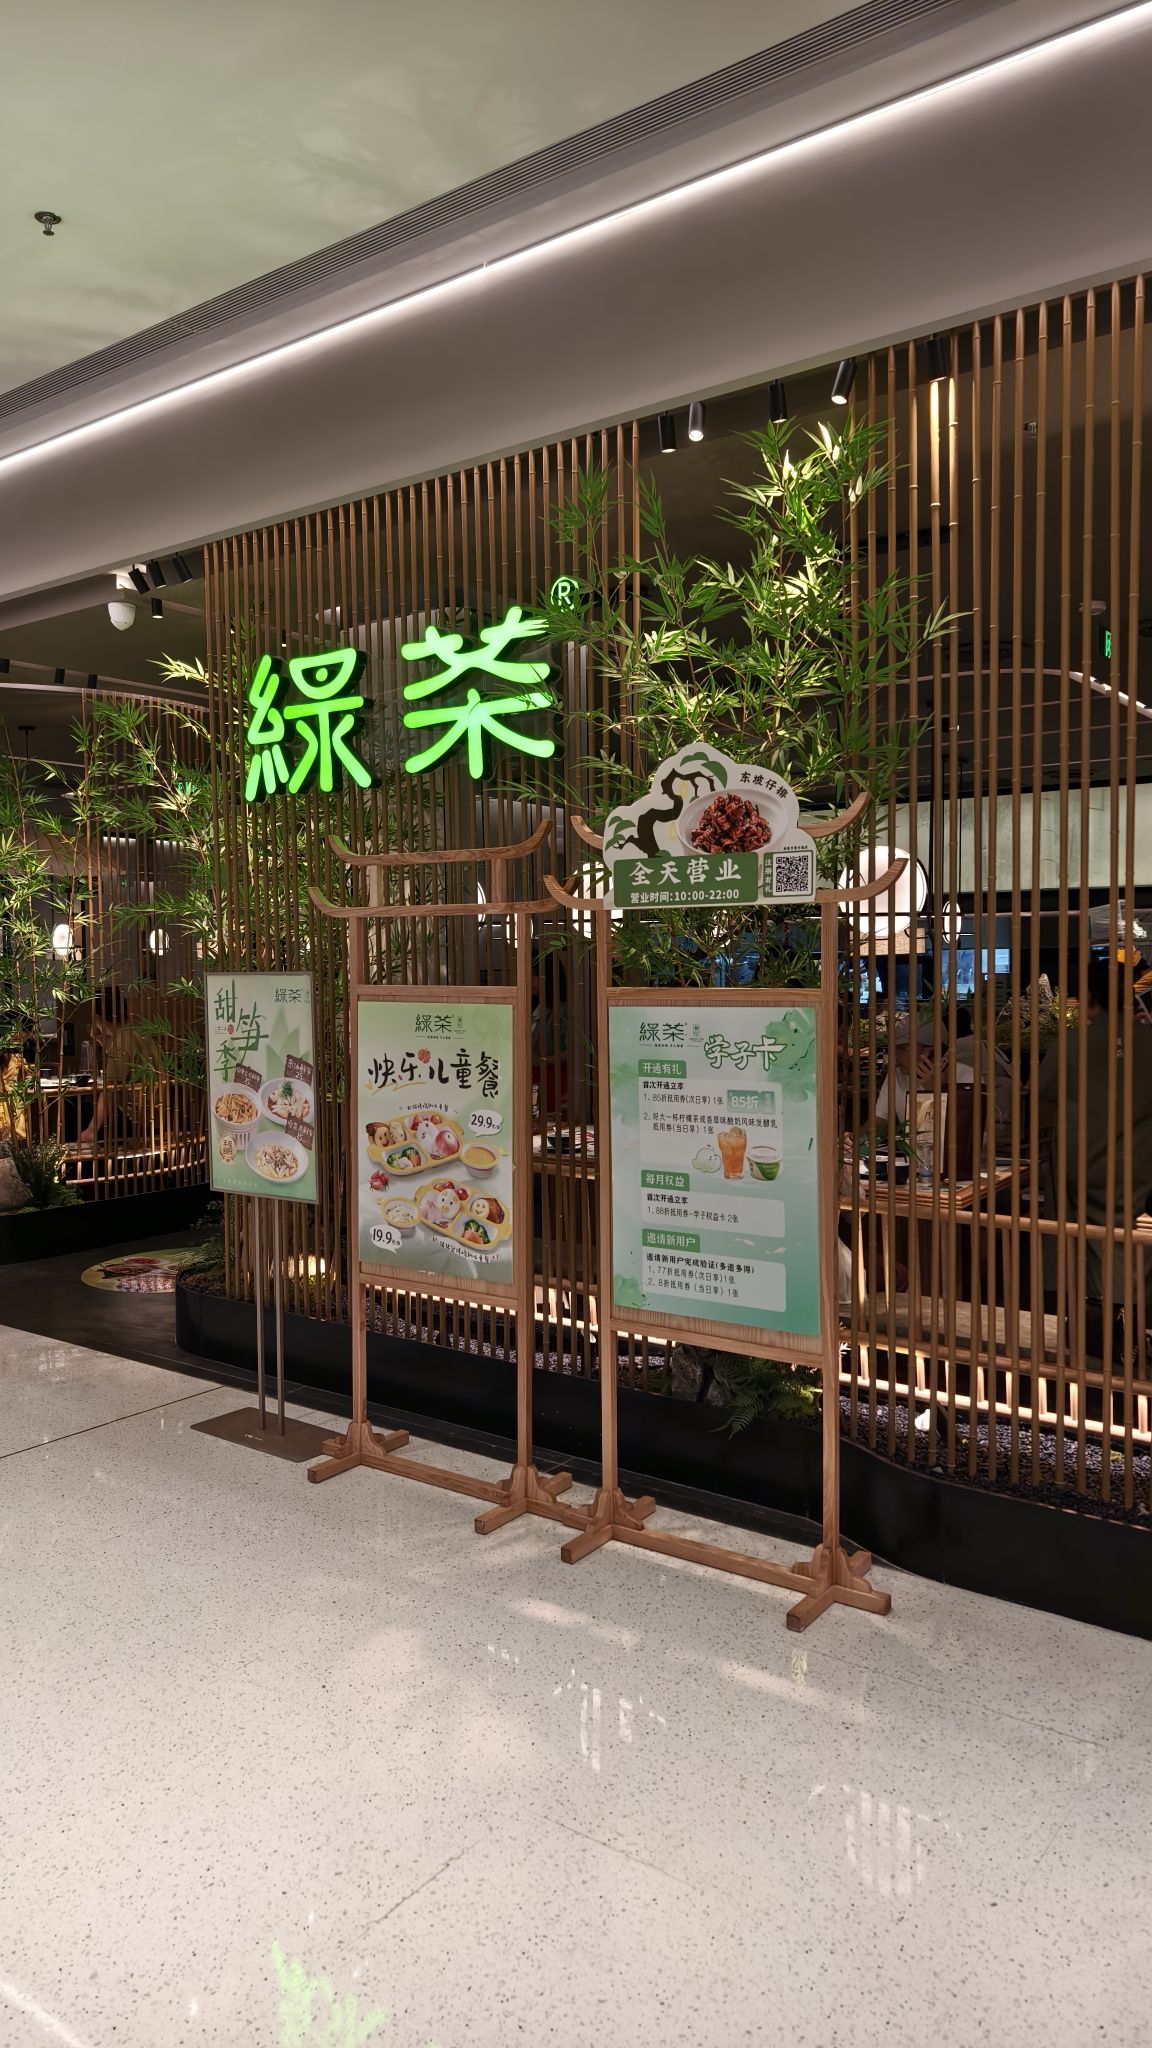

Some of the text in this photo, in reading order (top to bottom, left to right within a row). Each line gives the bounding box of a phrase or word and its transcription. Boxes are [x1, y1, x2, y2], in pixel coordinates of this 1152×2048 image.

[740, 771, 789, 799] 东坡仔排
[628, 857, 742, 886] 全天营业
[630, 888, 740, 904] 营业时间:10:00-22:00
[703, 1034, 788, 1072] 学子卡
[367, 1047, 500, 1099] 快乐儿童餐
[642, 1062, 682, 1075] 开通有礼
[642, 1081, 684, 1090] 首次开通立享
[646, 1173, 685, 1188] 每月权益
[646, 1193, 689, 1205] 首次开通立享
[646, 1232, 696, 1247] 邀请新用户
